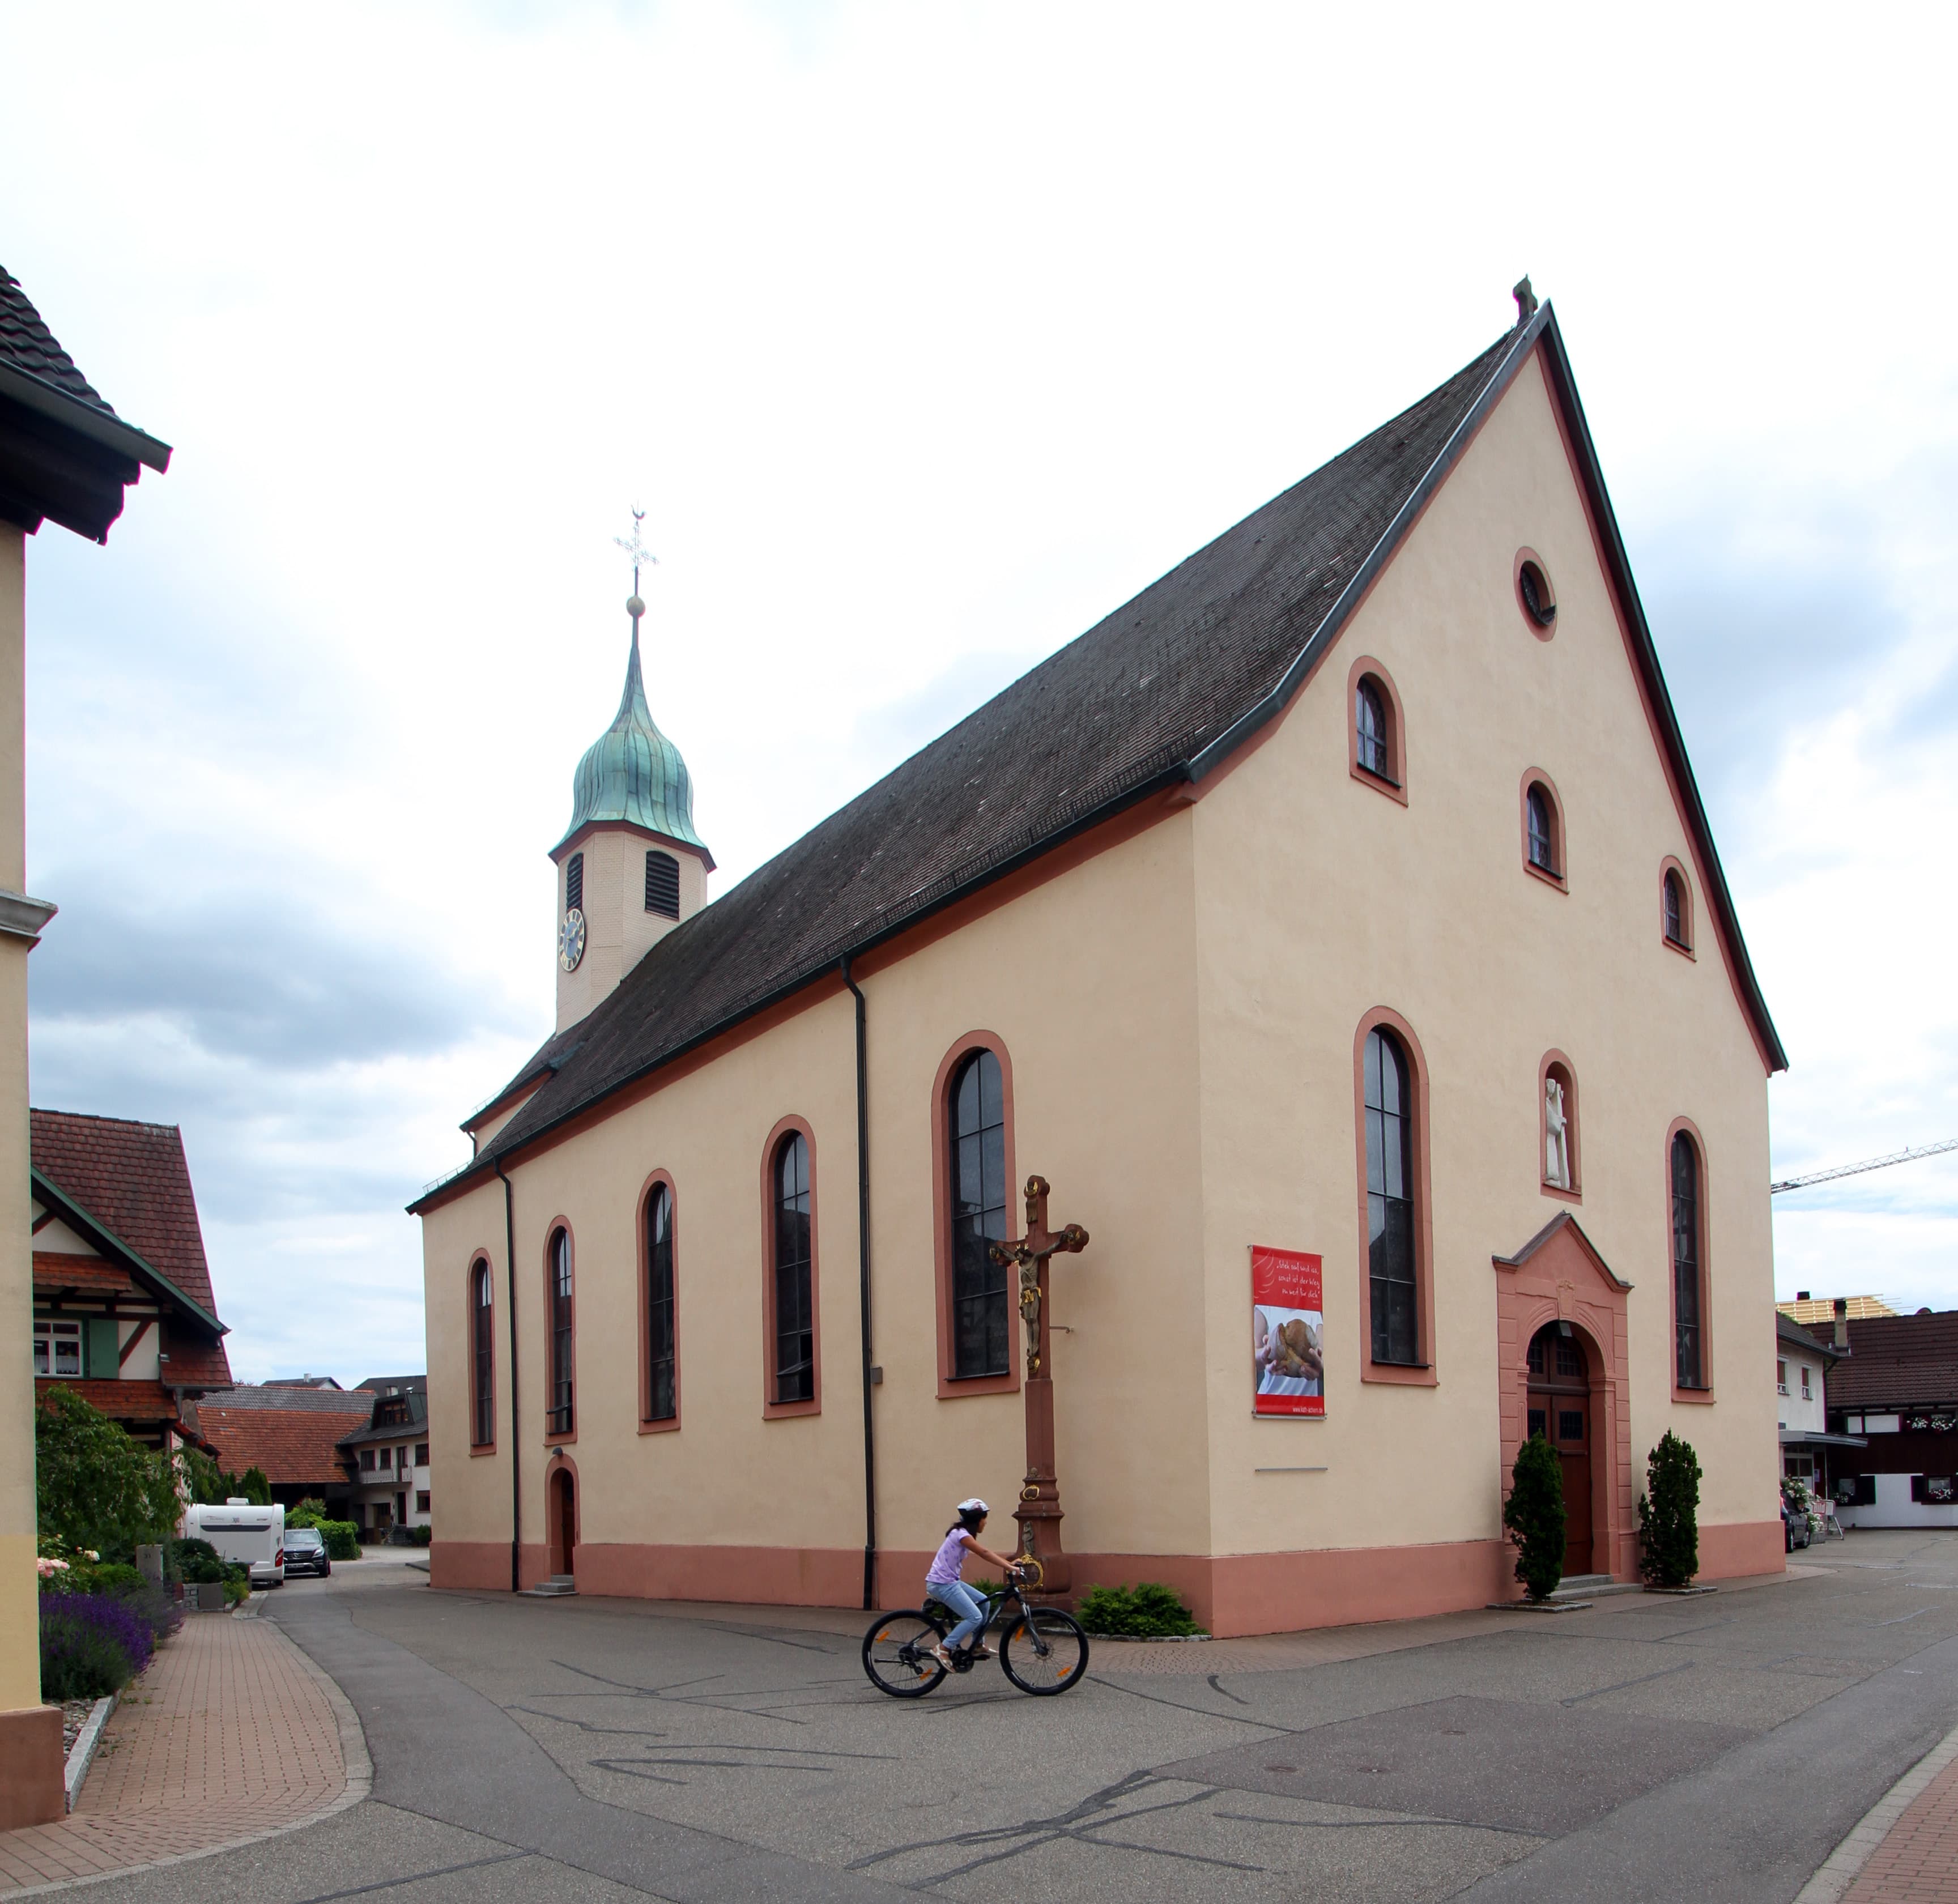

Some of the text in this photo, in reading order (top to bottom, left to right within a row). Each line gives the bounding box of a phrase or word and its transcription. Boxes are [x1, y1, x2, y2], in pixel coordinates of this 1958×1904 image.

[1278, 1273, 1291, 1283] sonst
[1300, 1276, 1308, 1285] der
[1309, 1277, 1320, 1289] Weg
